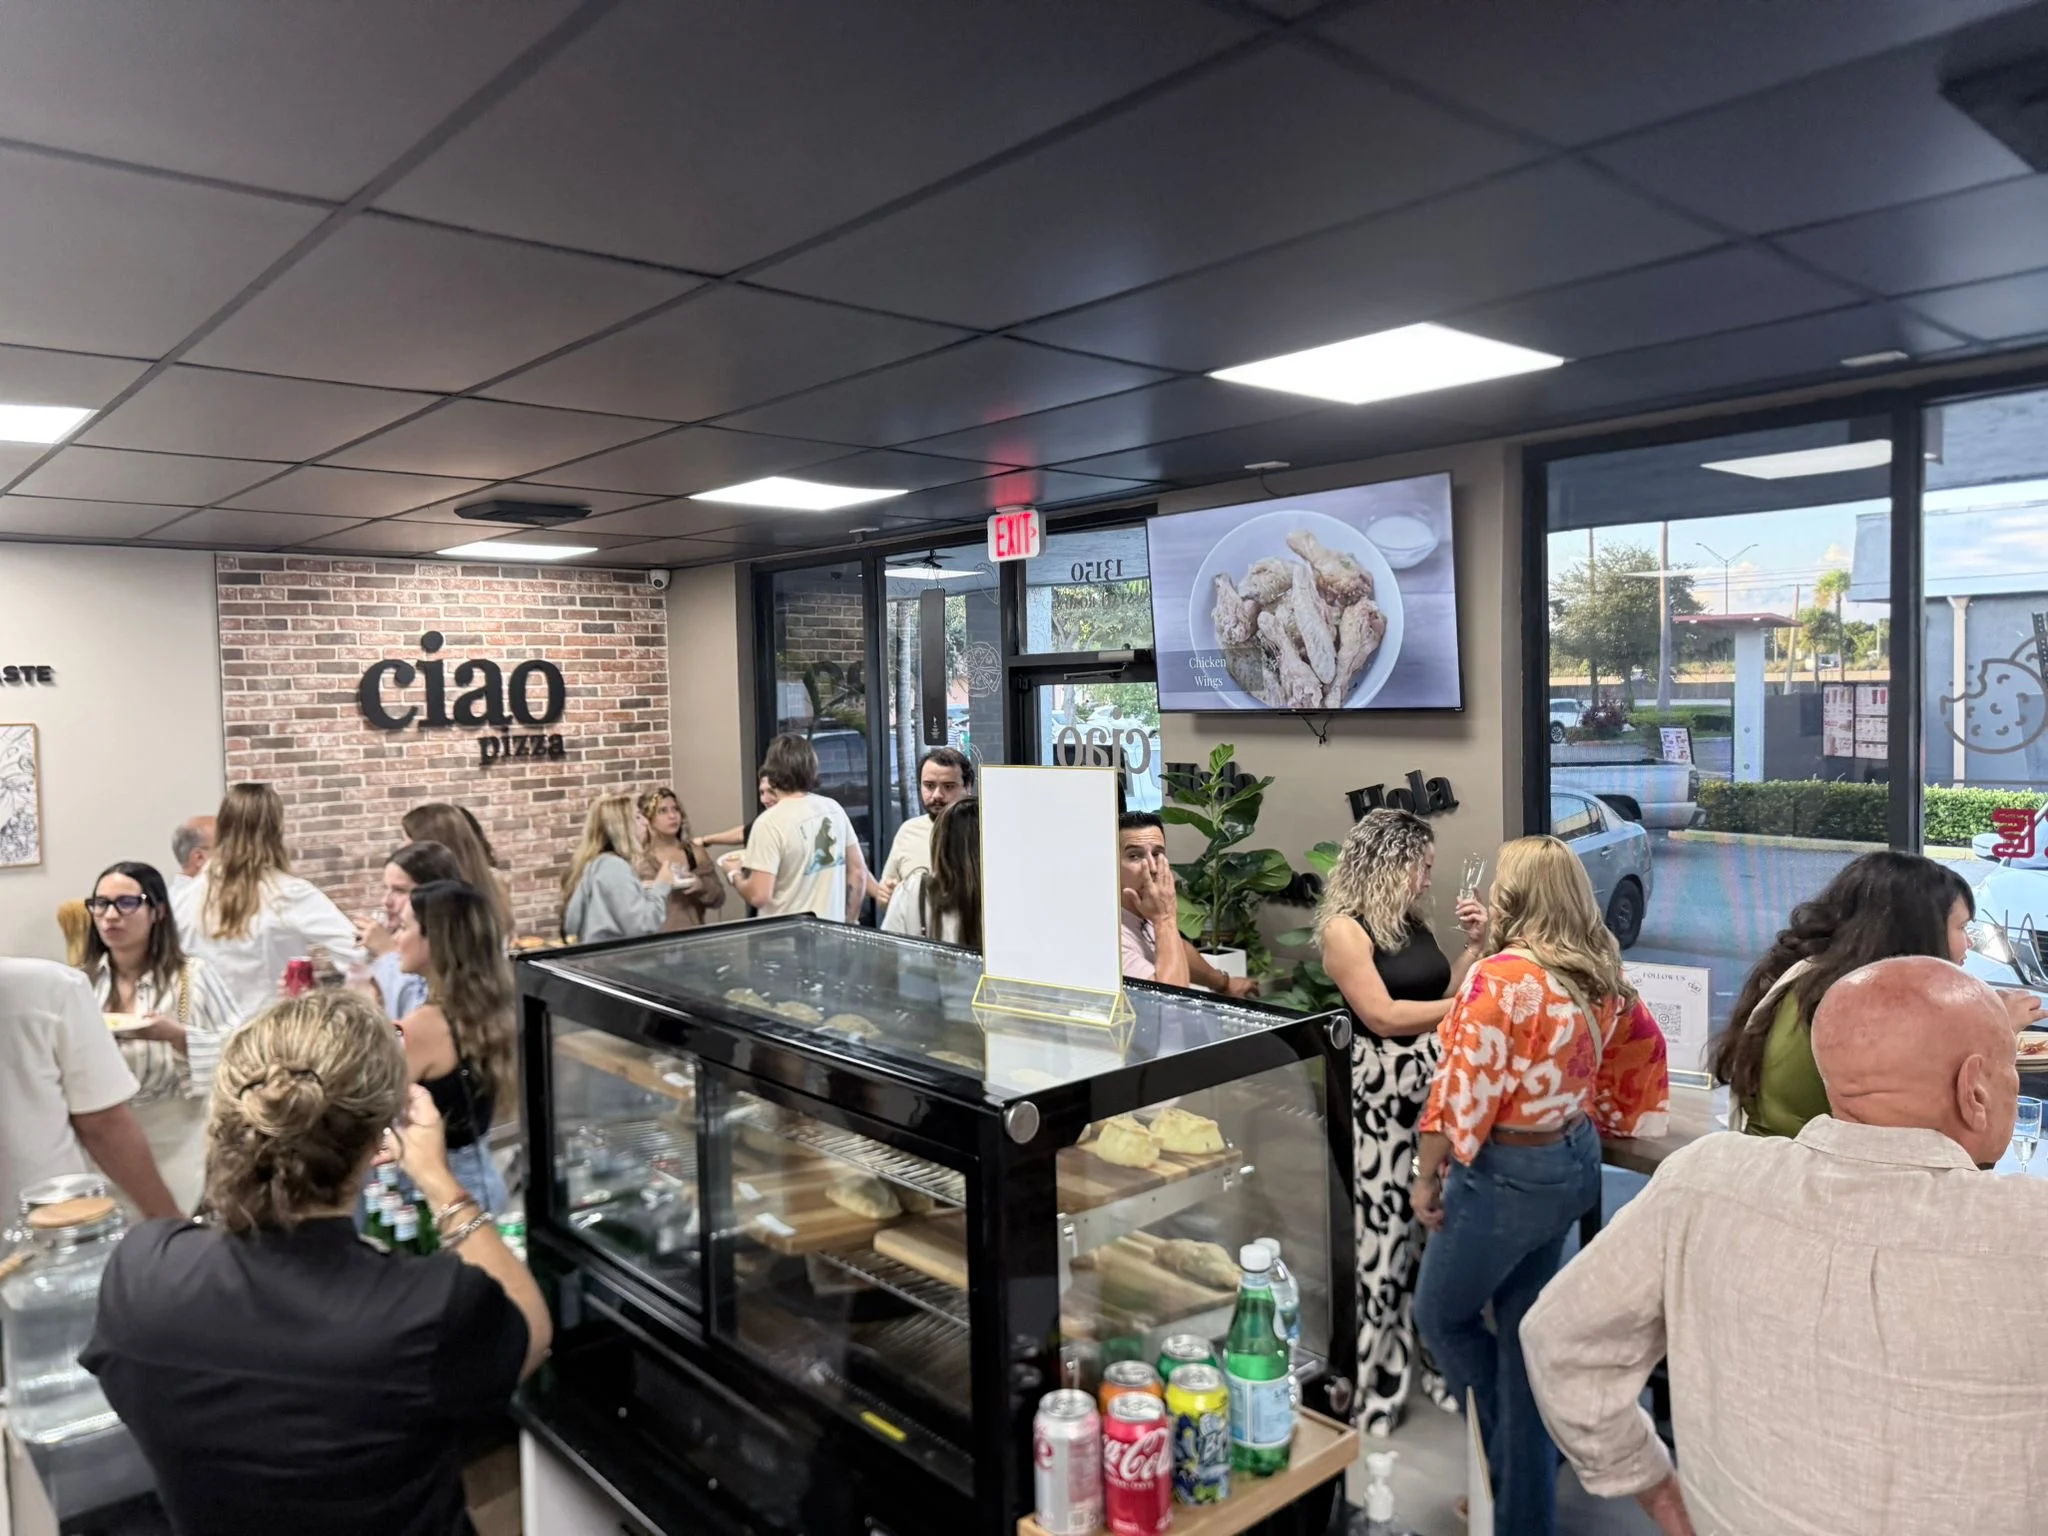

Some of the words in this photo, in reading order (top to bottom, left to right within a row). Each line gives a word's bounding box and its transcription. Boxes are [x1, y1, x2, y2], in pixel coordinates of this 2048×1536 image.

[995, 512, 1032, 557] EXIT
[0, 665, 53, 683] STE
[1189, 656, 1226, 669] Chicken
[359, 630, 566, 730] ciao
[1195, 675, 1224, 688] Wings
[478, 727, 566, 766] pizza
[1345, 769, 1460, 822] Hola
[1642, 972, 1673, 980] FOLLOW
